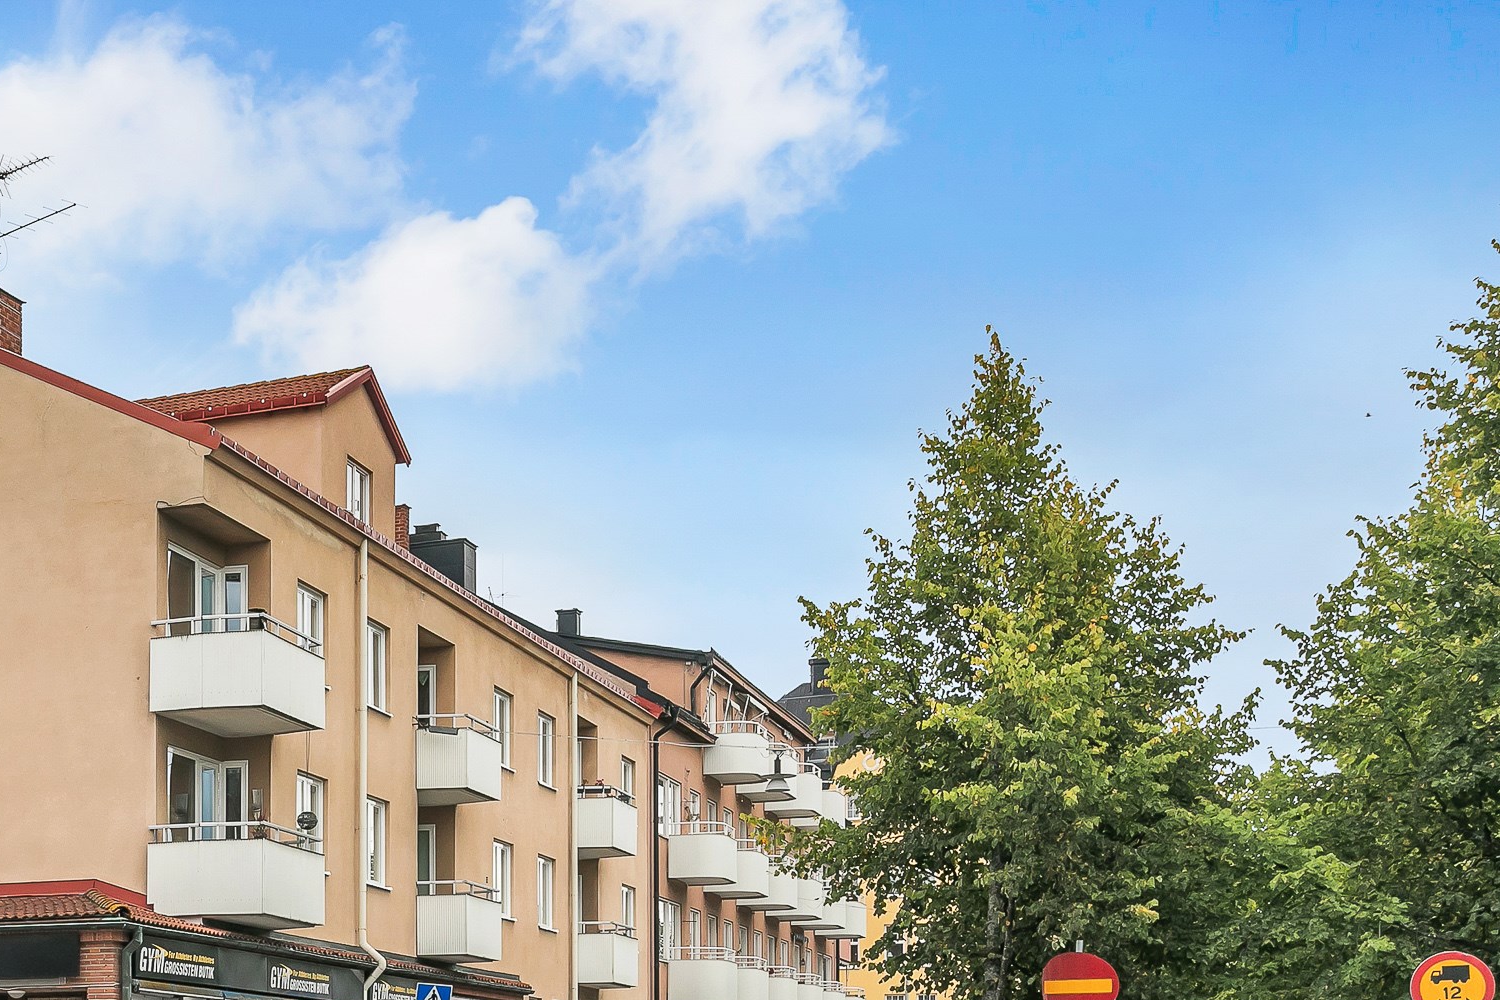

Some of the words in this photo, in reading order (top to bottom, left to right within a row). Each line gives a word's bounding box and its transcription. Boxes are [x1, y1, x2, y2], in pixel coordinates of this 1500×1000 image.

[139, 946, 164, 973] GYM
[164, 960, 198, 978] GROSSISTEN
[199, 966, 214, 979] BUTIK
[270, 966, 290, 990] GYM
[290, 978, 317, 993] GROSSISTEN
[317, 982, 329, 994] BUTIK
[1443, 987, 1461, 999] 12
